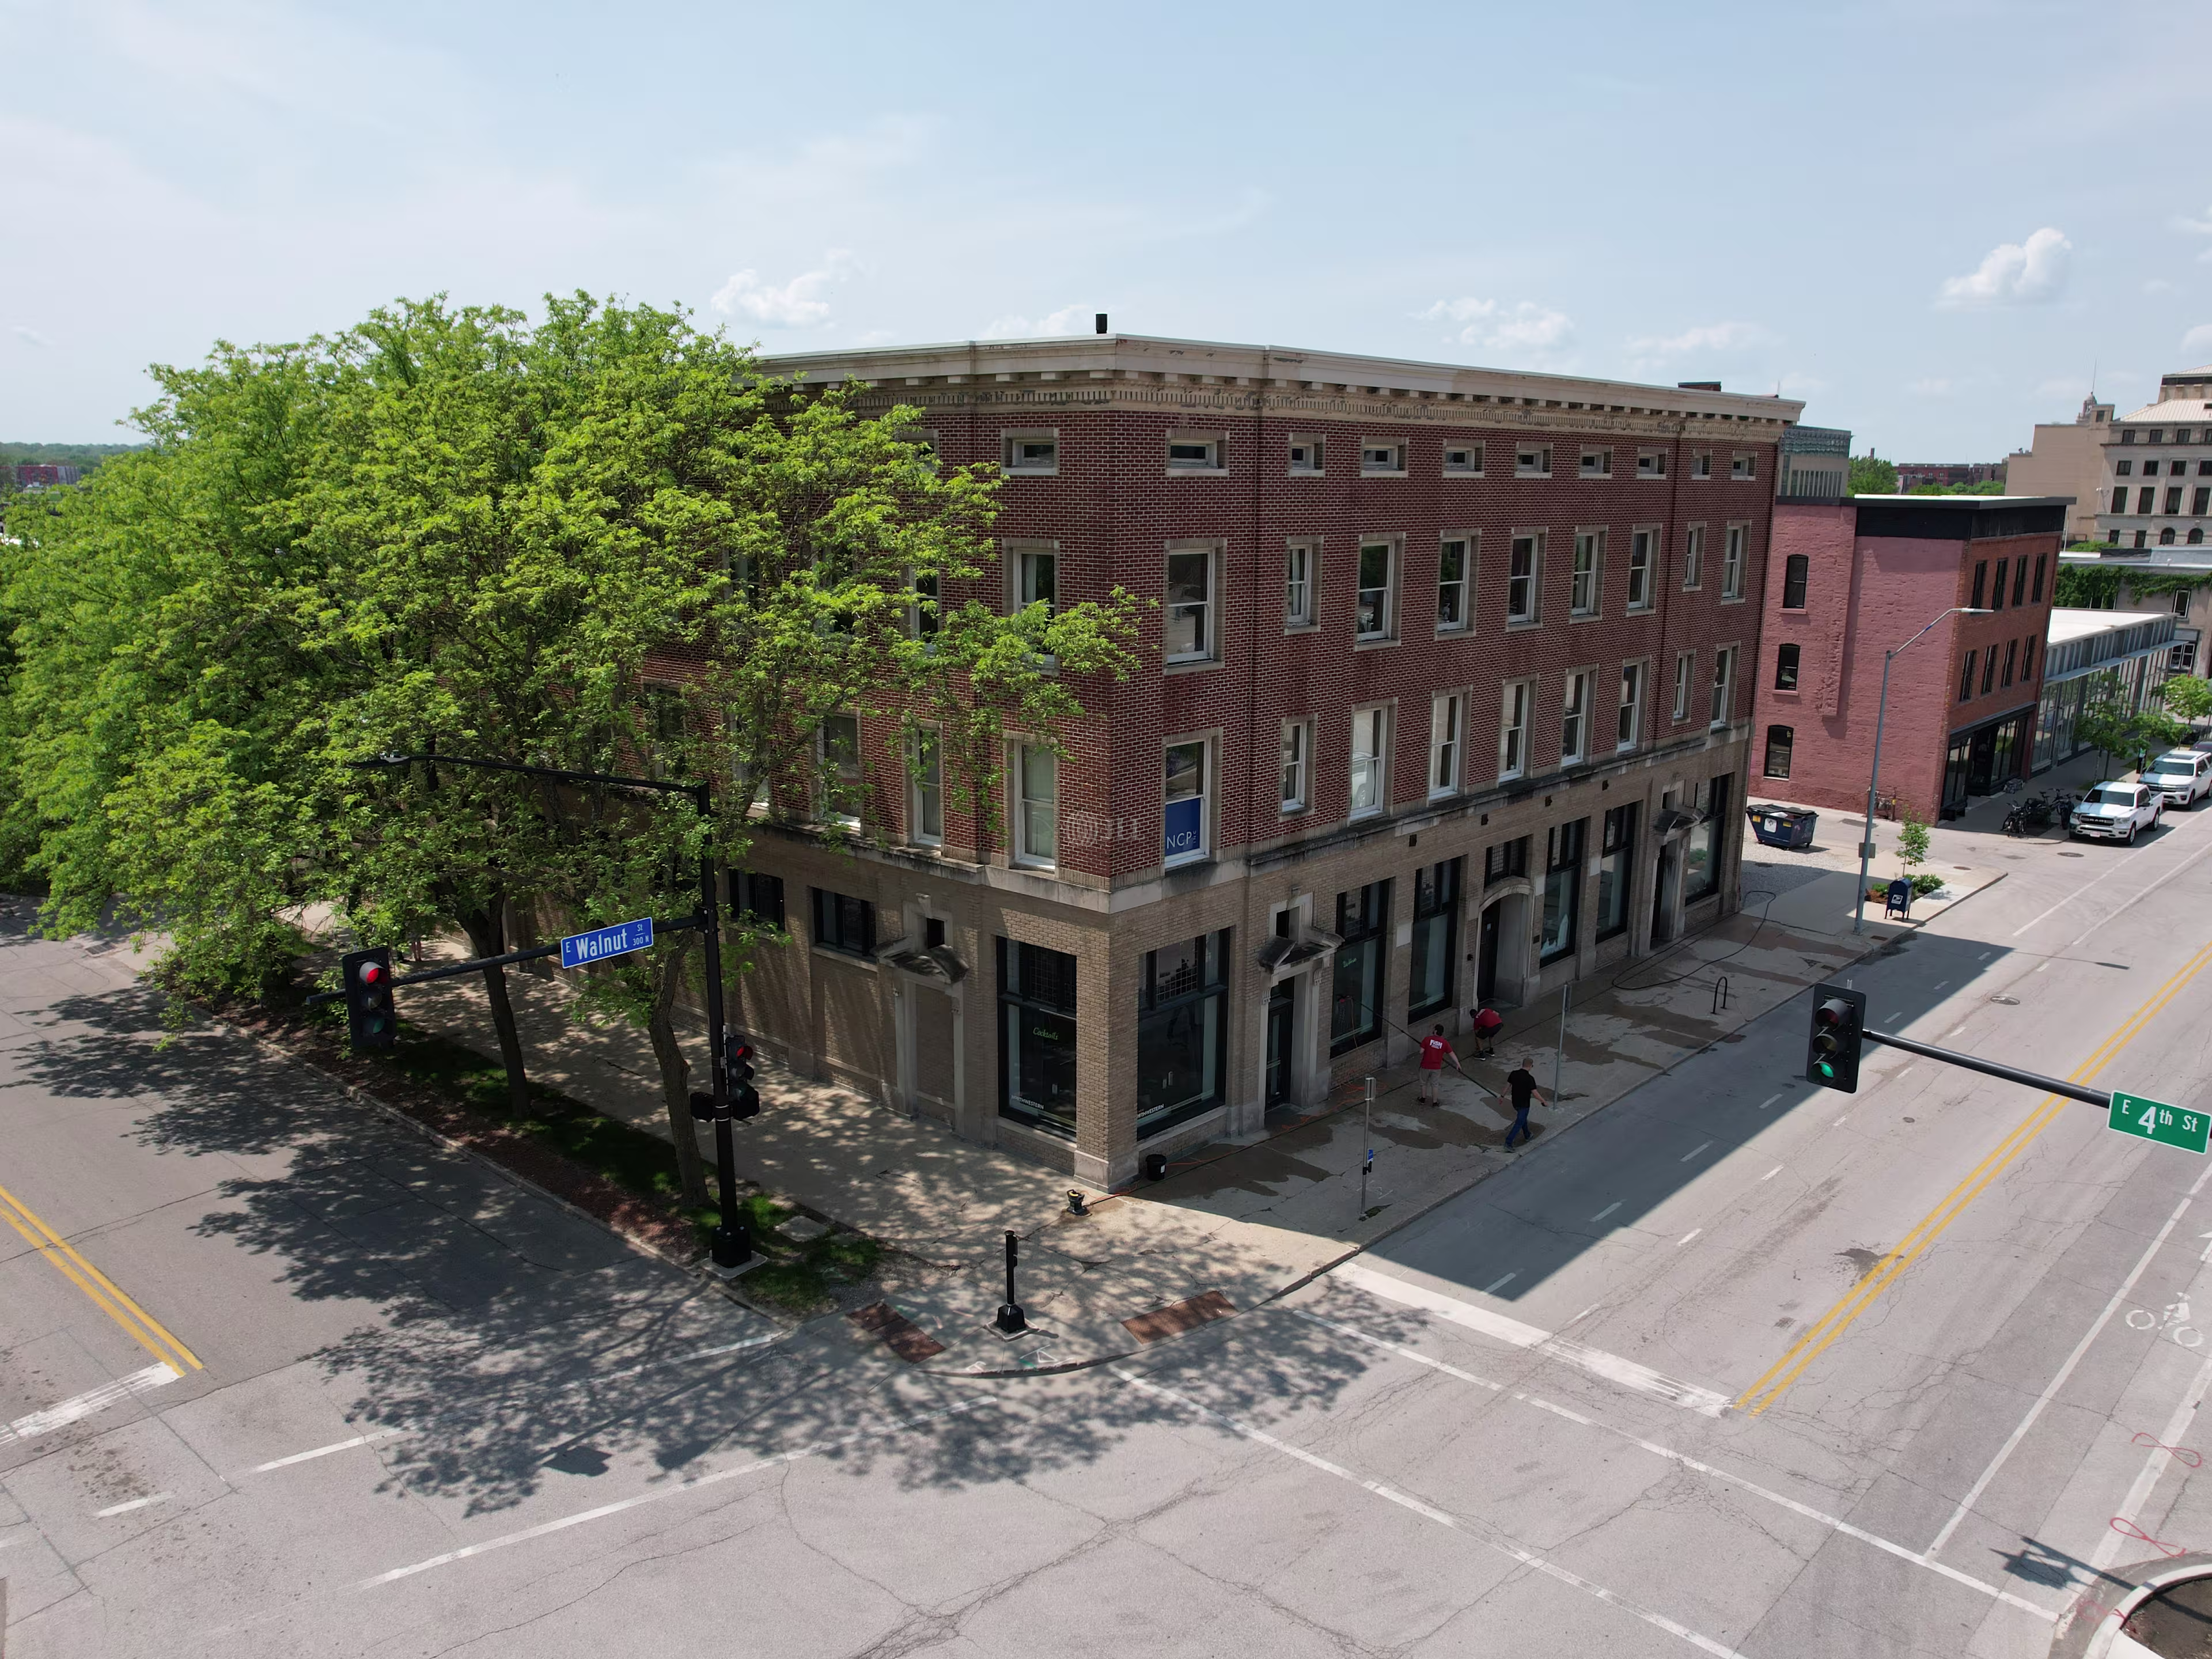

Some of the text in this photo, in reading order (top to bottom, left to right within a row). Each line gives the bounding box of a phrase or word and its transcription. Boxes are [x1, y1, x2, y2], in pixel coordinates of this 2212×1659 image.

[1166, 831, 1192, 849] NCP
[637, 923, 643, 931] St
[566, 927, 628, 960] E Walnut
[632, 935, 649, 946] 300 N
[1033, 1027, 1059, 1040] Cocktails
[2122, 1099, 2198, 1135] E 4th St
